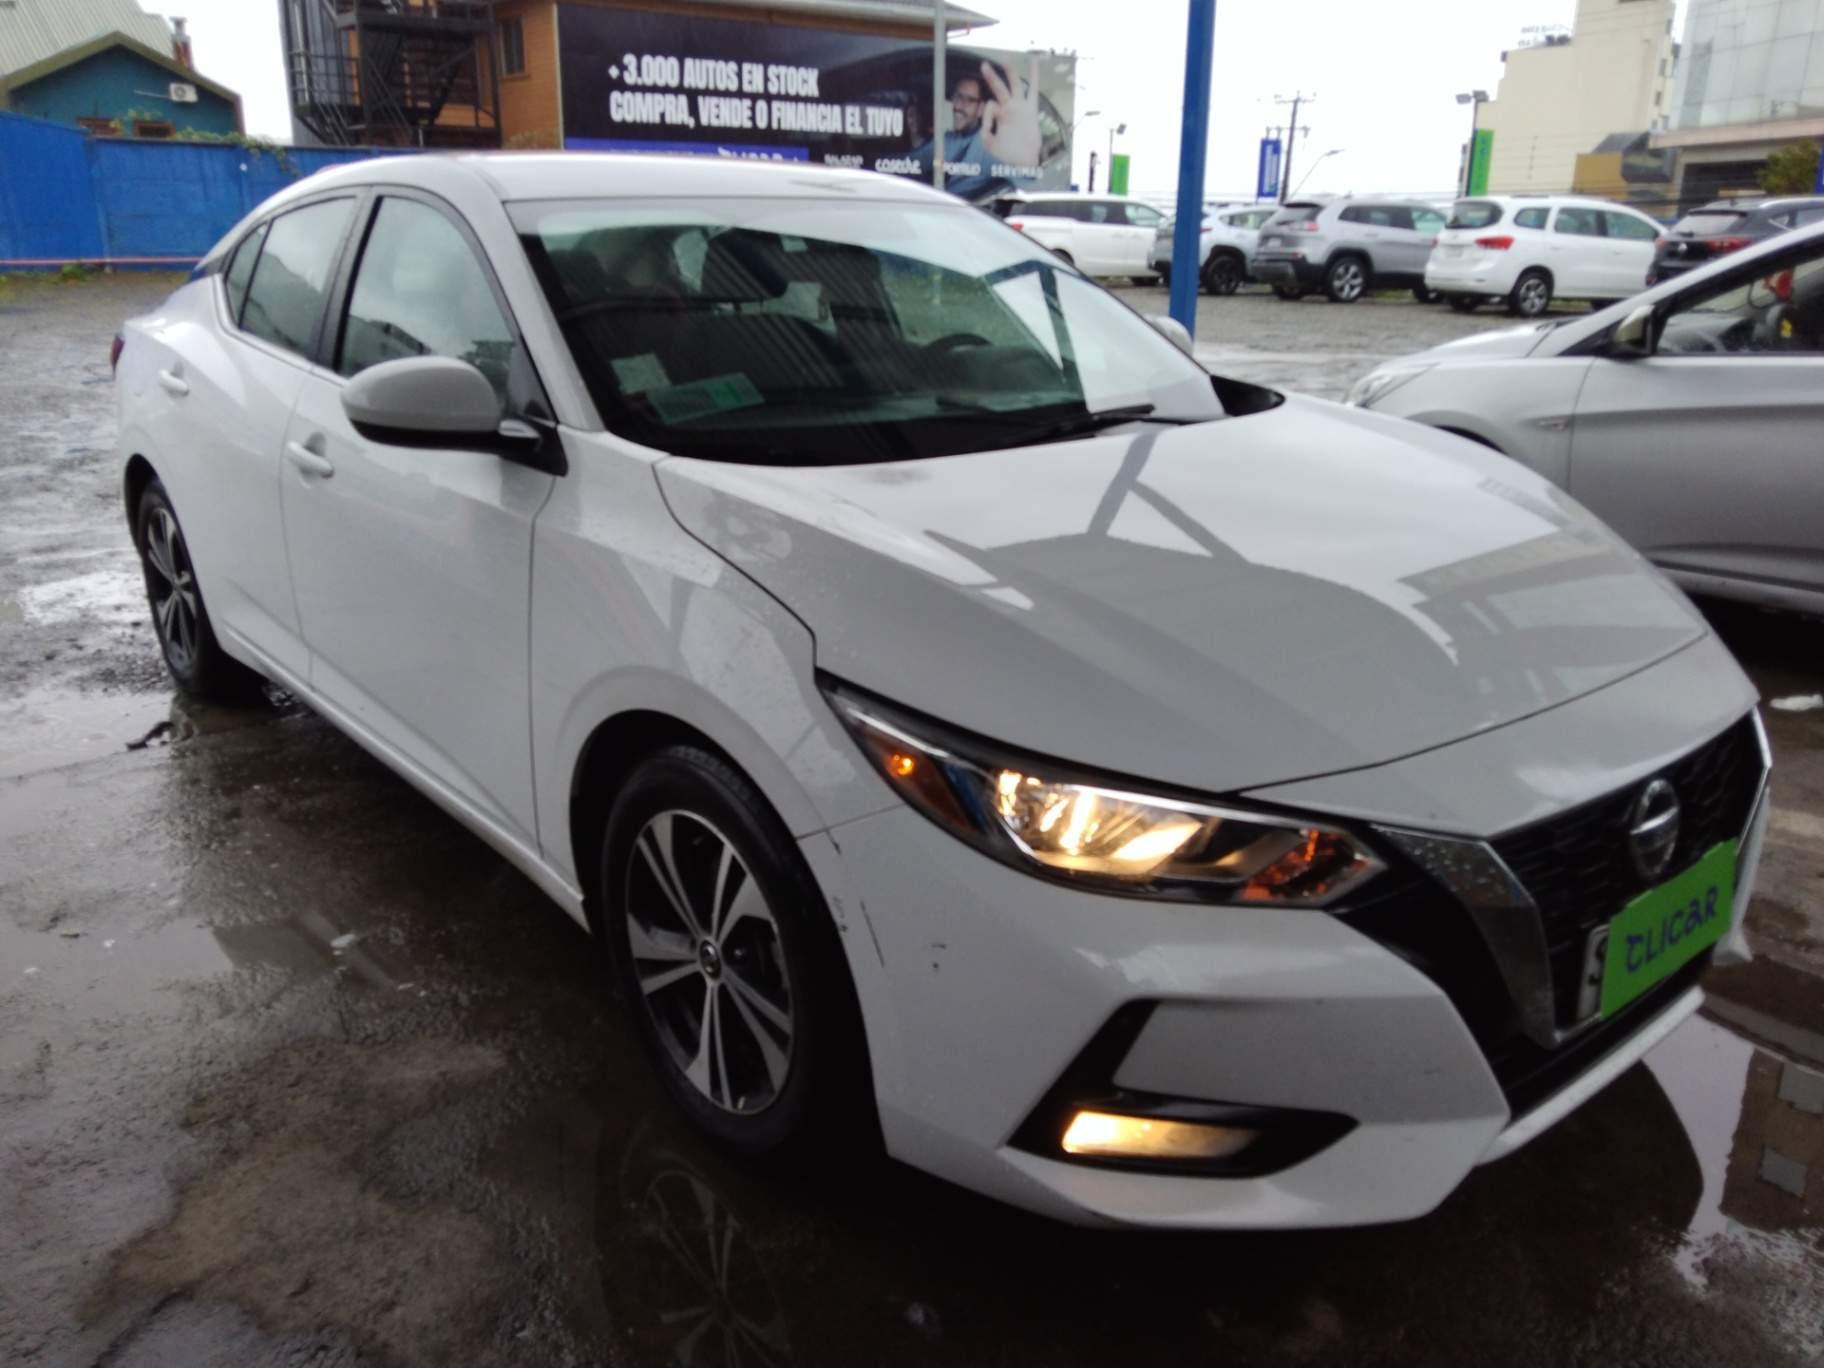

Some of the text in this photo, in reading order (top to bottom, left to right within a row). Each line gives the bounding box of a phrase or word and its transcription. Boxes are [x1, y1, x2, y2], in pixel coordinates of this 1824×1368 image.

[622, 53, 680, 88] 3.000
[683, 57, 739, 92] AUTOS
[741, 62, 765, 93] EN
[767, 64, 820, 98] STOCK
[609, 90, 904, 137] COMPRA, VENDE O FINANCIA EL TUYO
